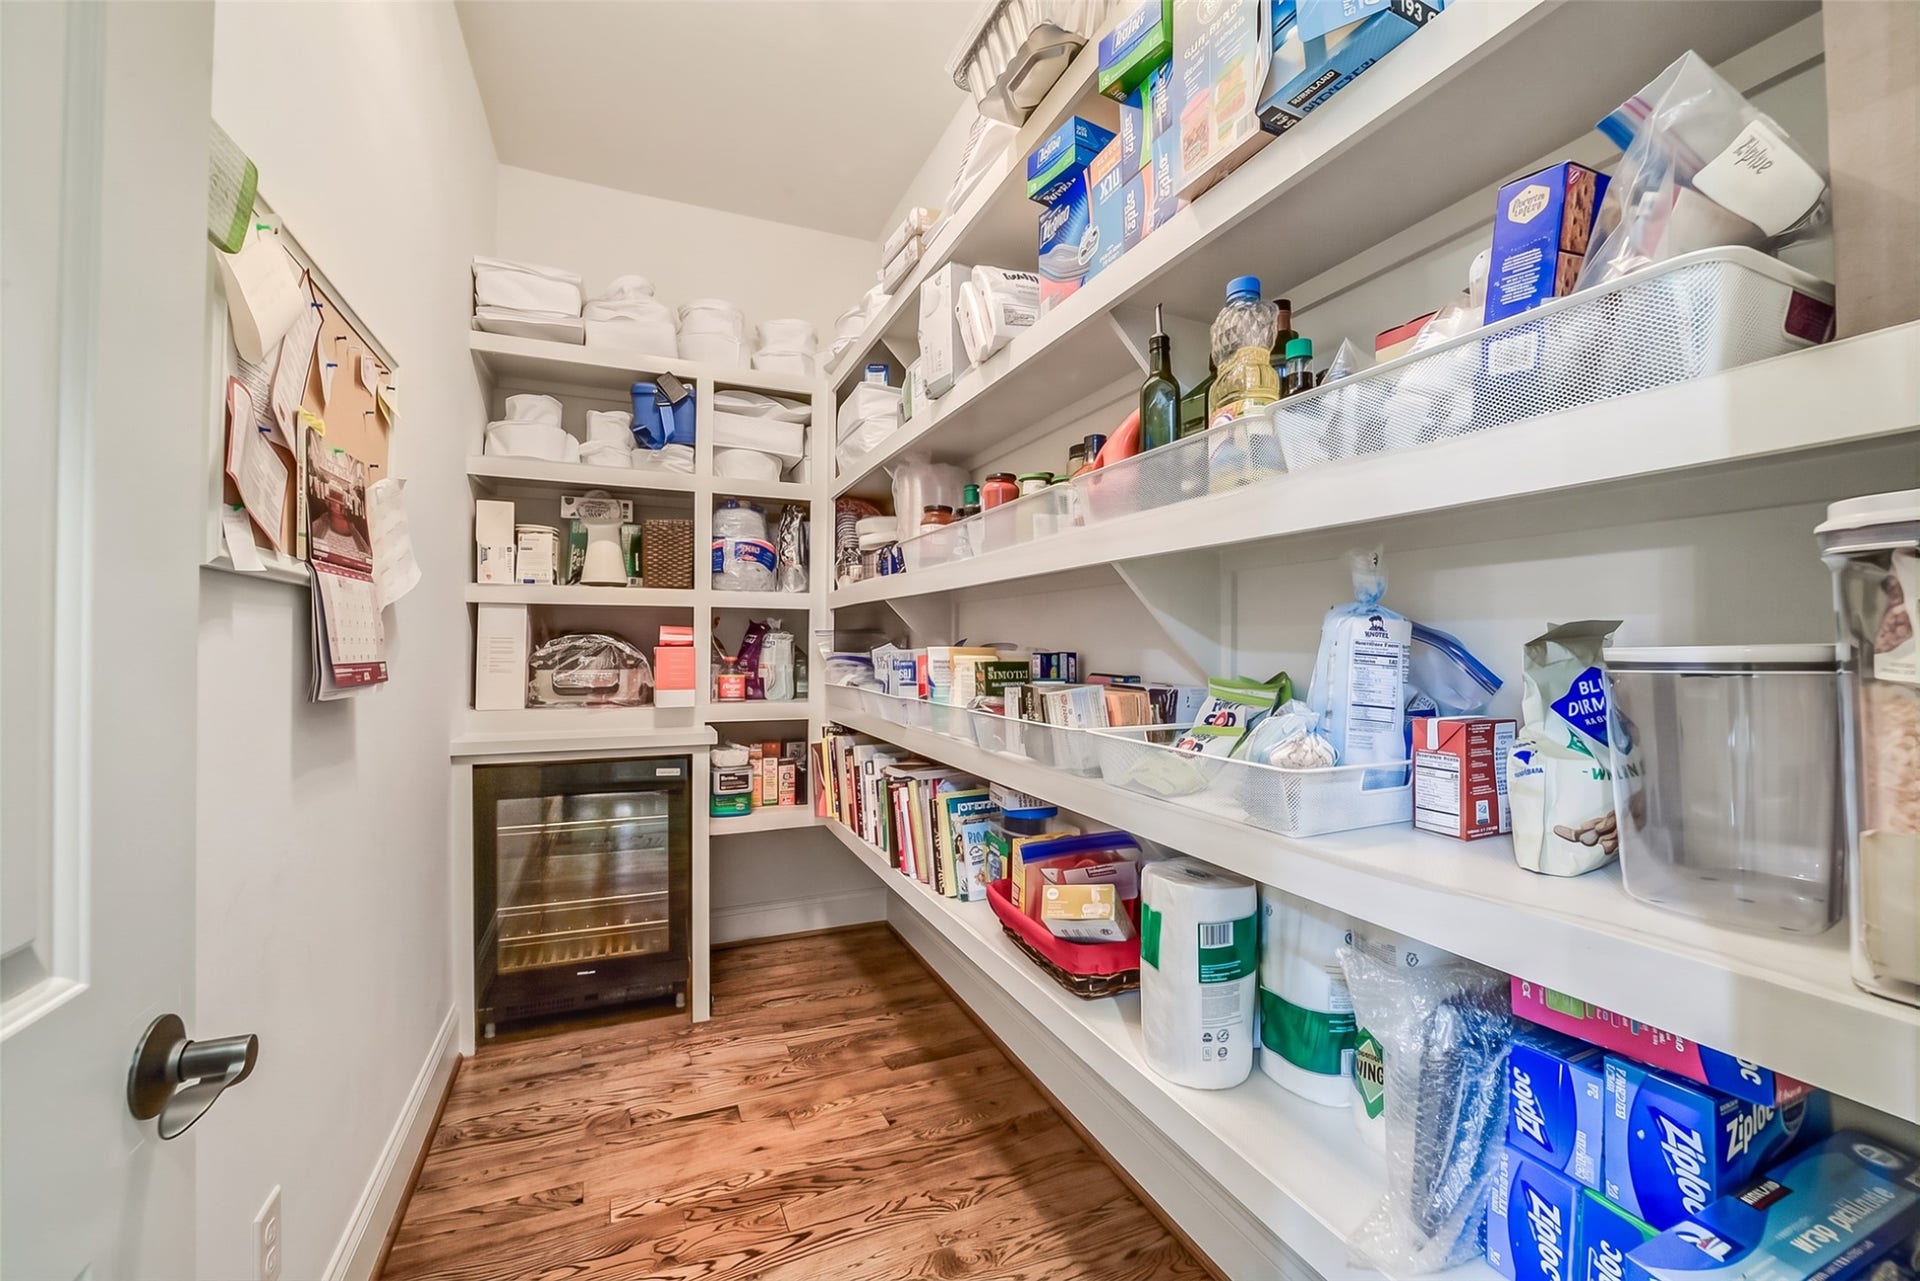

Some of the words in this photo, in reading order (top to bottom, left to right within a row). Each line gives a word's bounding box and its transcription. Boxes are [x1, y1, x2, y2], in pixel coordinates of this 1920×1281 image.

[1510, 1065, 1546, 1146] Ziploc
[1659, 1114, 1712, 1217] Ziploc
[1527, 1187, 1564, 1281] Ziploc
